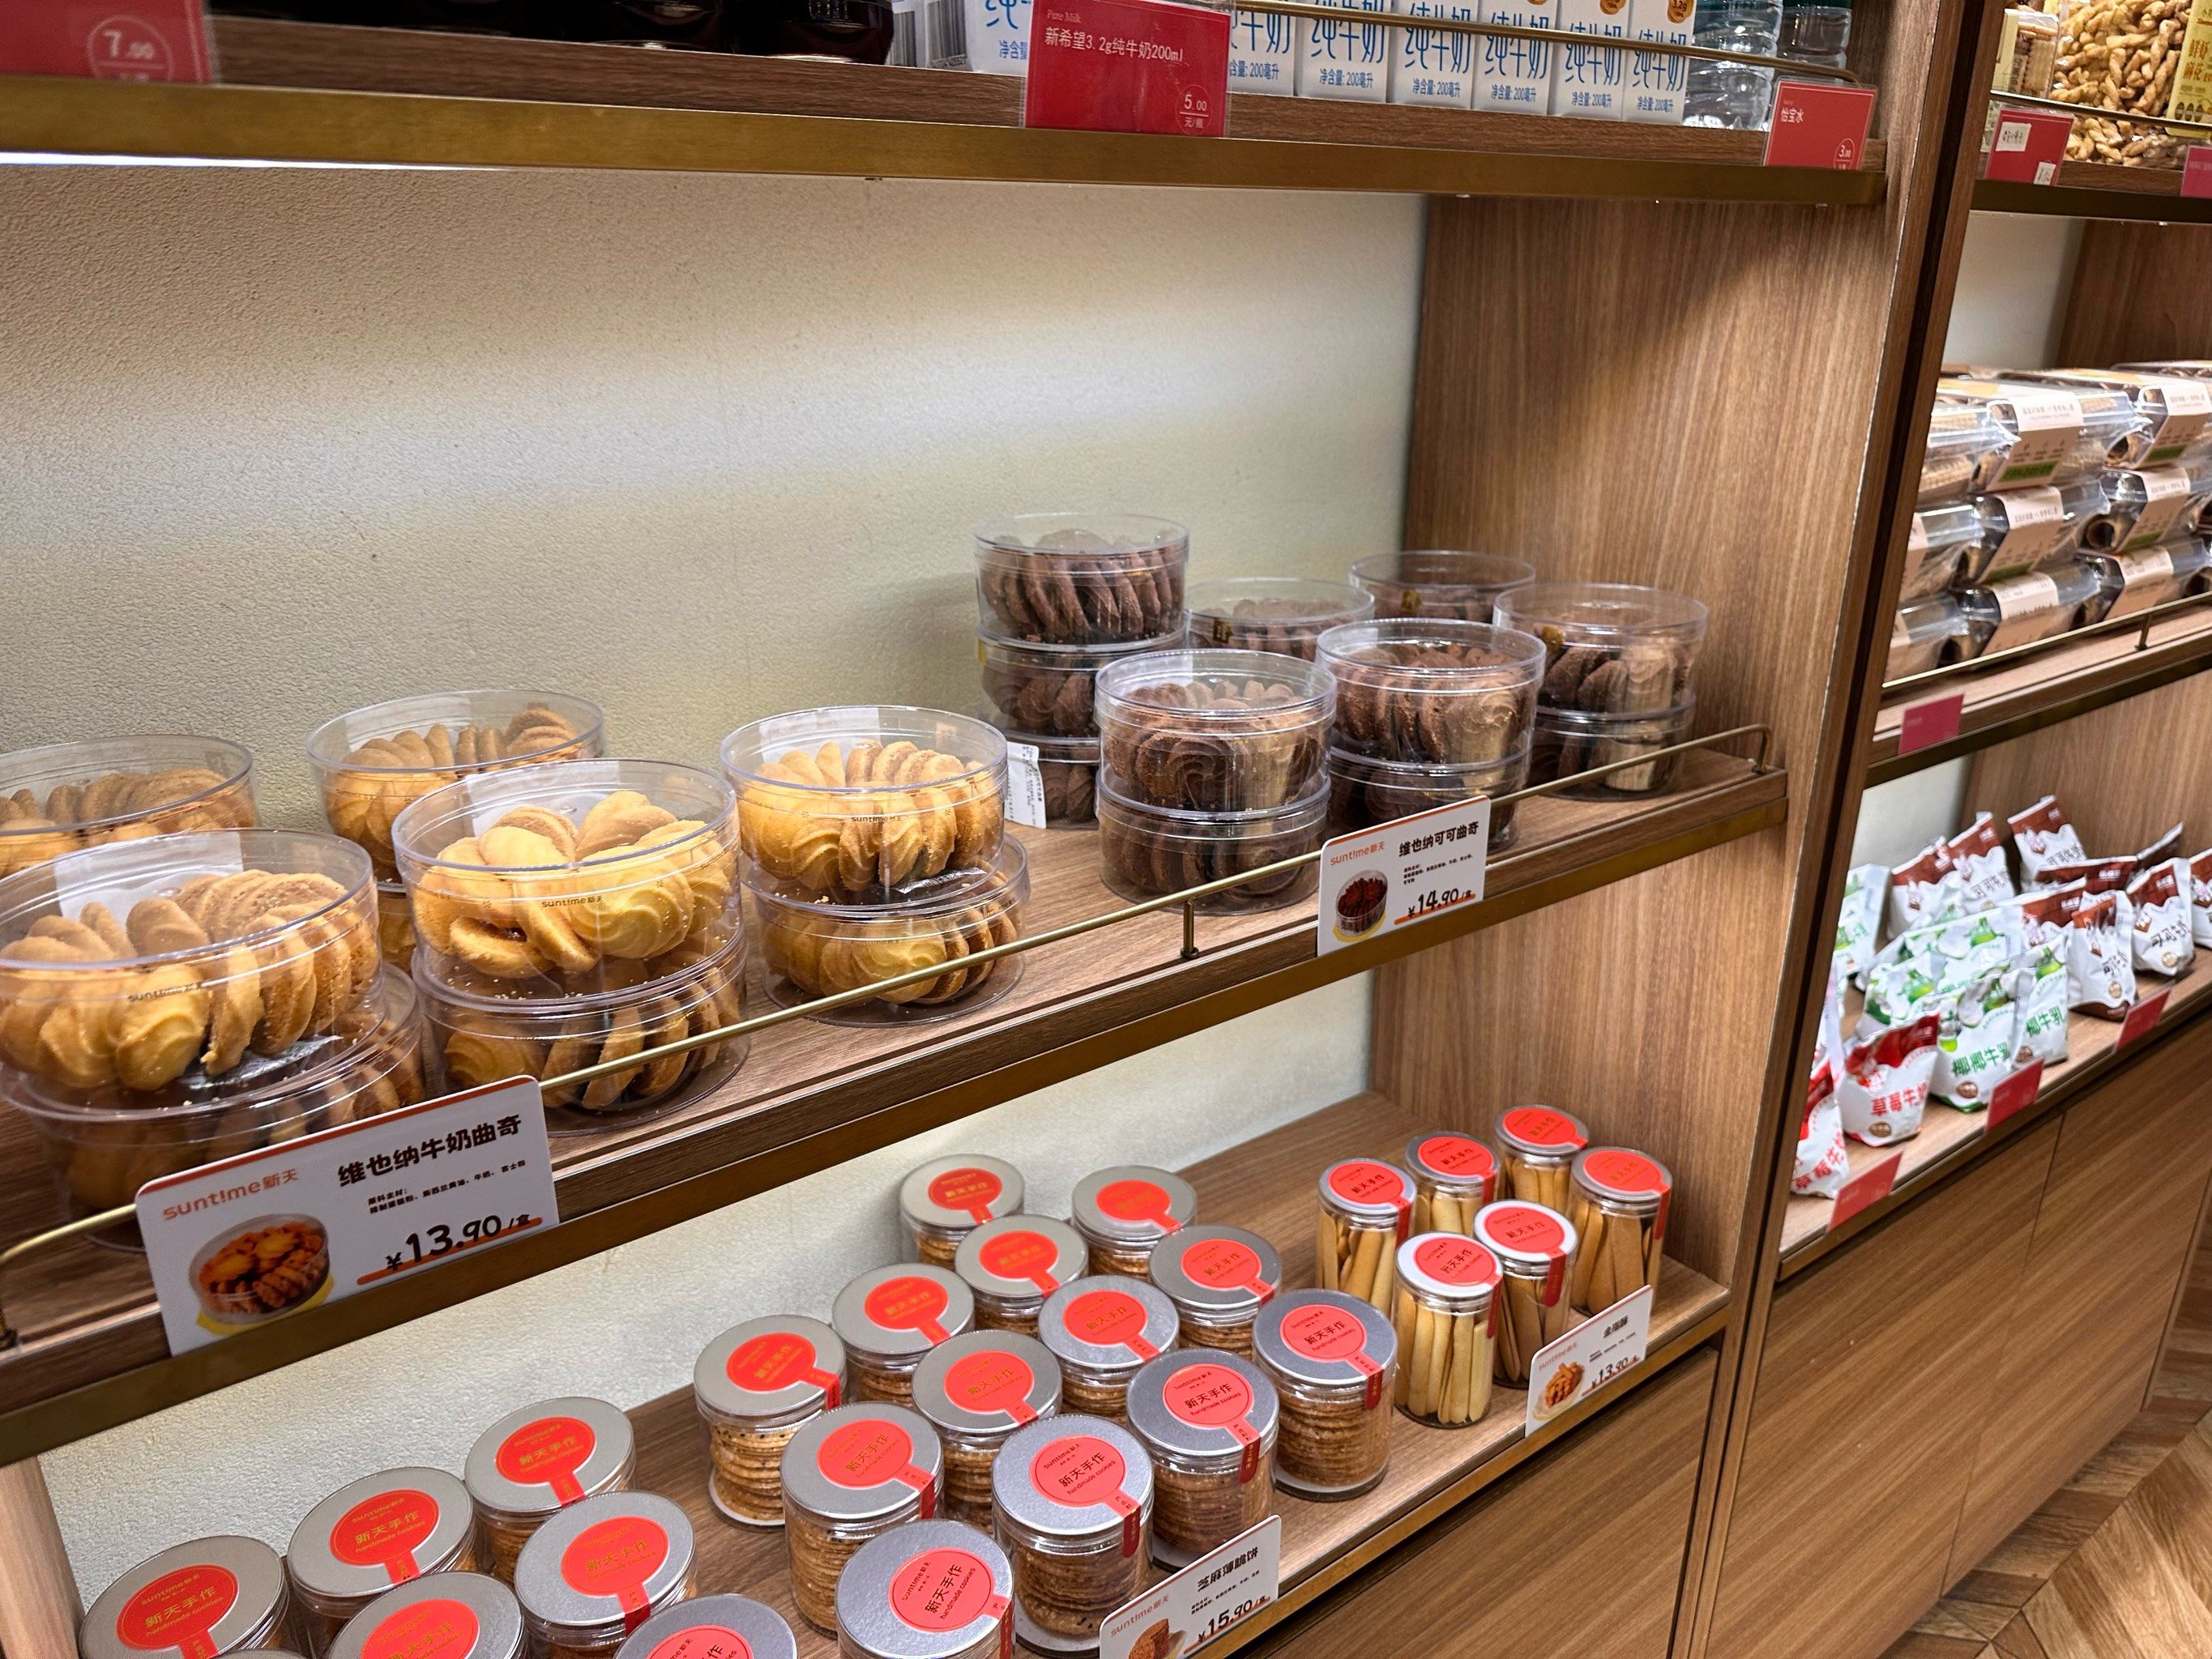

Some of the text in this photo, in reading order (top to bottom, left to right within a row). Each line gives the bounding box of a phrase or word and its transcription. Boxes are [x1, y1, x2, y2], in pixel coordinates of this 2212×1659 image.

[1405, 2, 1471, 74] 纯牛奶
[1484, 11, 1549, 79] 纯牛奶
[1565, 22, 1621, 86] 纯牛奶
[1632, 29, 1687, 92] 纯牛奶
[1184, 93, 1207, 112] 5.00
[1330, 841, 1386, 866] suntime新天
[1399, 821, 1479, 857] 维也纳可可曲奇
[540, 894, 603, 908] suntime新天
[337, 1114, 522, 1188] 维也纳牛奶曲奇
[163, 1168, 299, 1221] suntime新天
[1303, 1320, 1346, 1345] 新天手作
[1184, 1383, 1232, 1410] 新天手作
[845, 1433, 889, 1472] 新天手作
[1057, 1452, 1106, 1488] 新天手作
[355, 1510, 420, 1545] 新天手作
[587, 1539, 649, 1572] 新天手作
[145, 1585, 216, 1628] 新天手作
[925, 1563, 963, 1614] 新天手作
